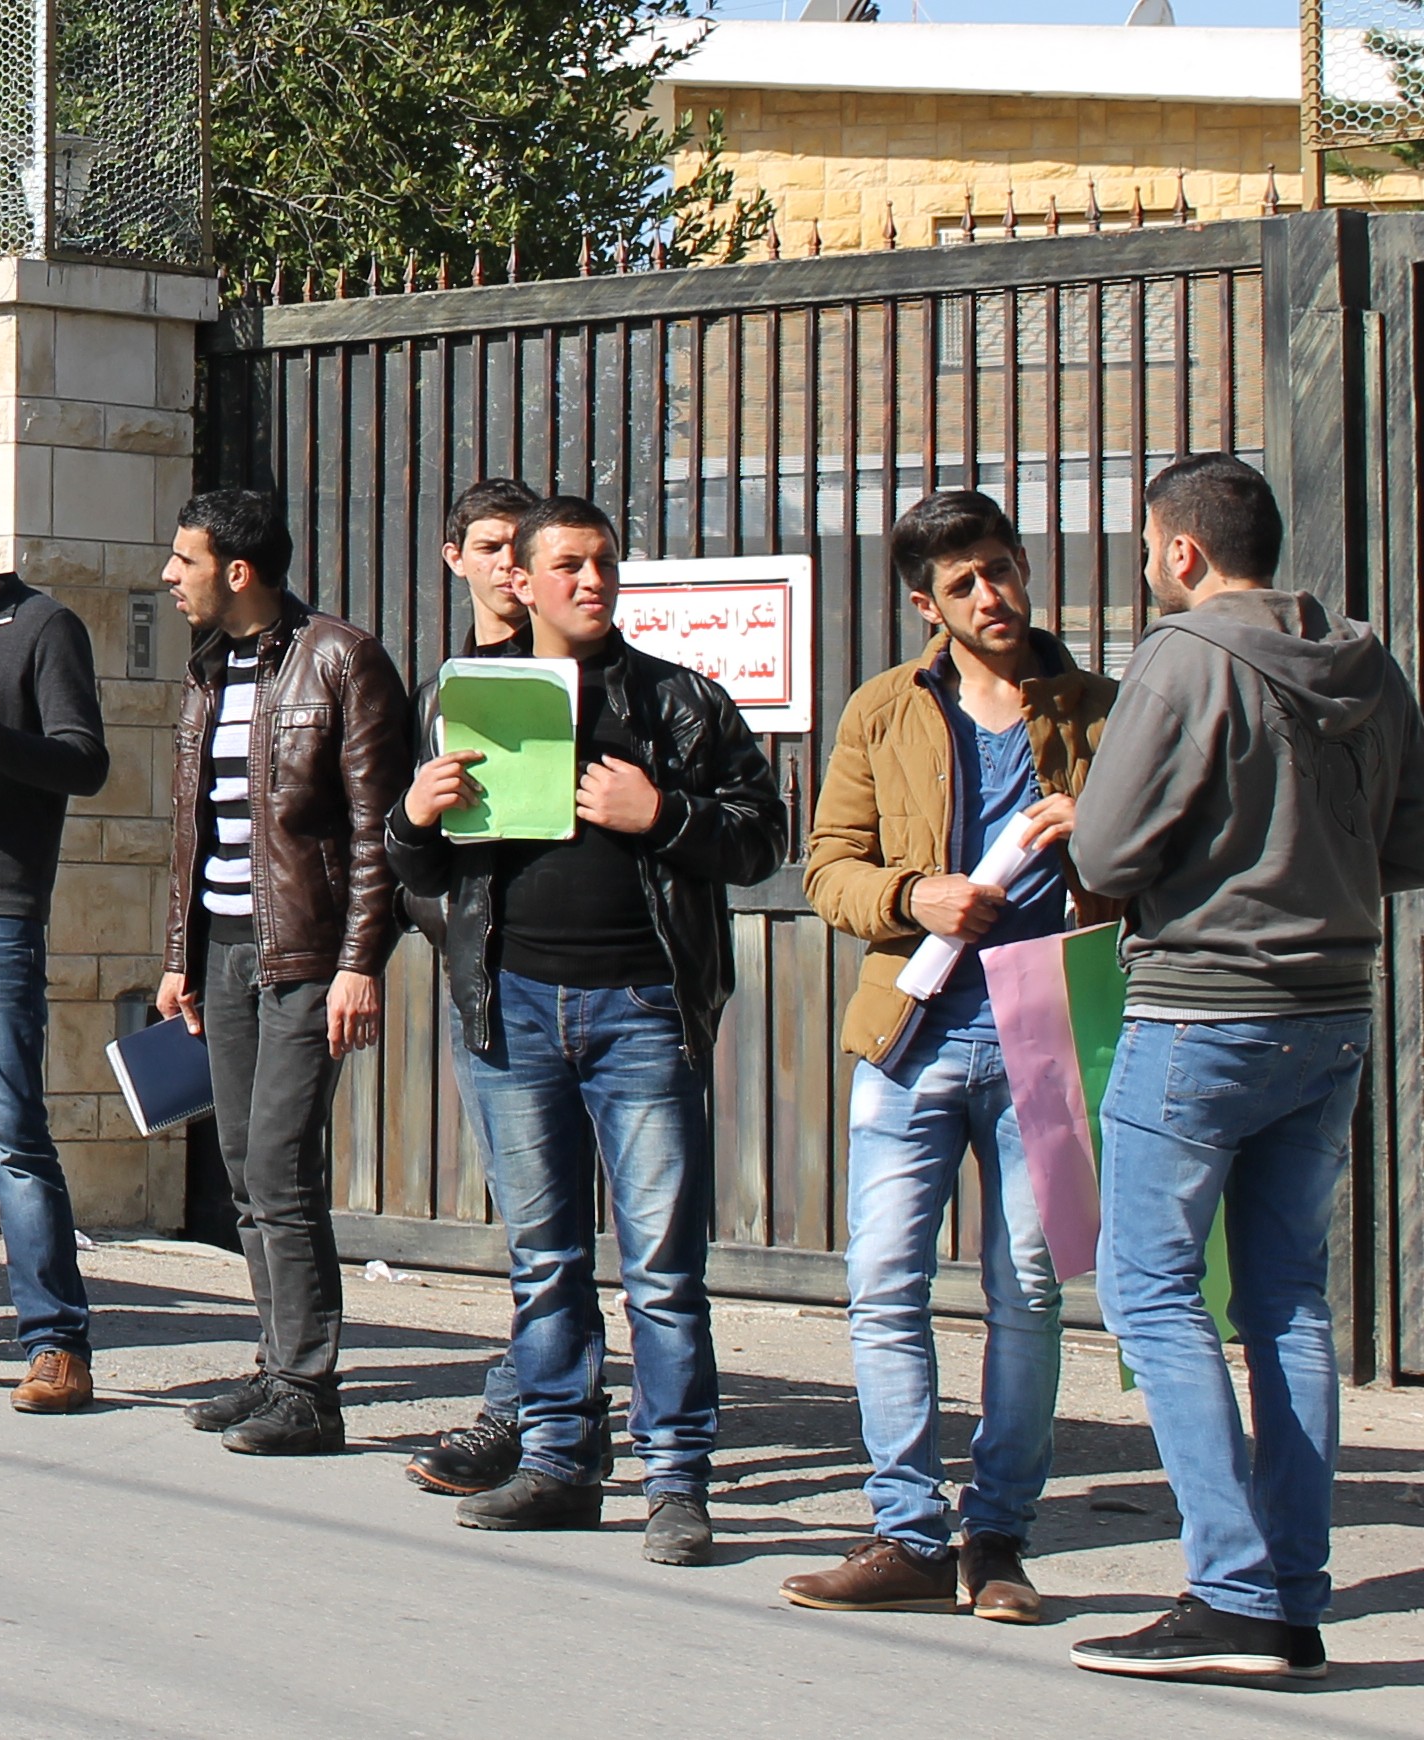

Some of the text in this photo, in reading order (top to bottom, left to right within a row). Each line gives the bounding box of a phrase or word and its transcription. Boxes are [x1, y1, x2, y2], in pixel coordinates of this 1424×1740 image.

[629, 608, 676, 639] الخلق
[681, 608, 730, 638] لحسن
[736, 601, 776, 637] شكرا
[732, 654, 776, 681] لعدم
